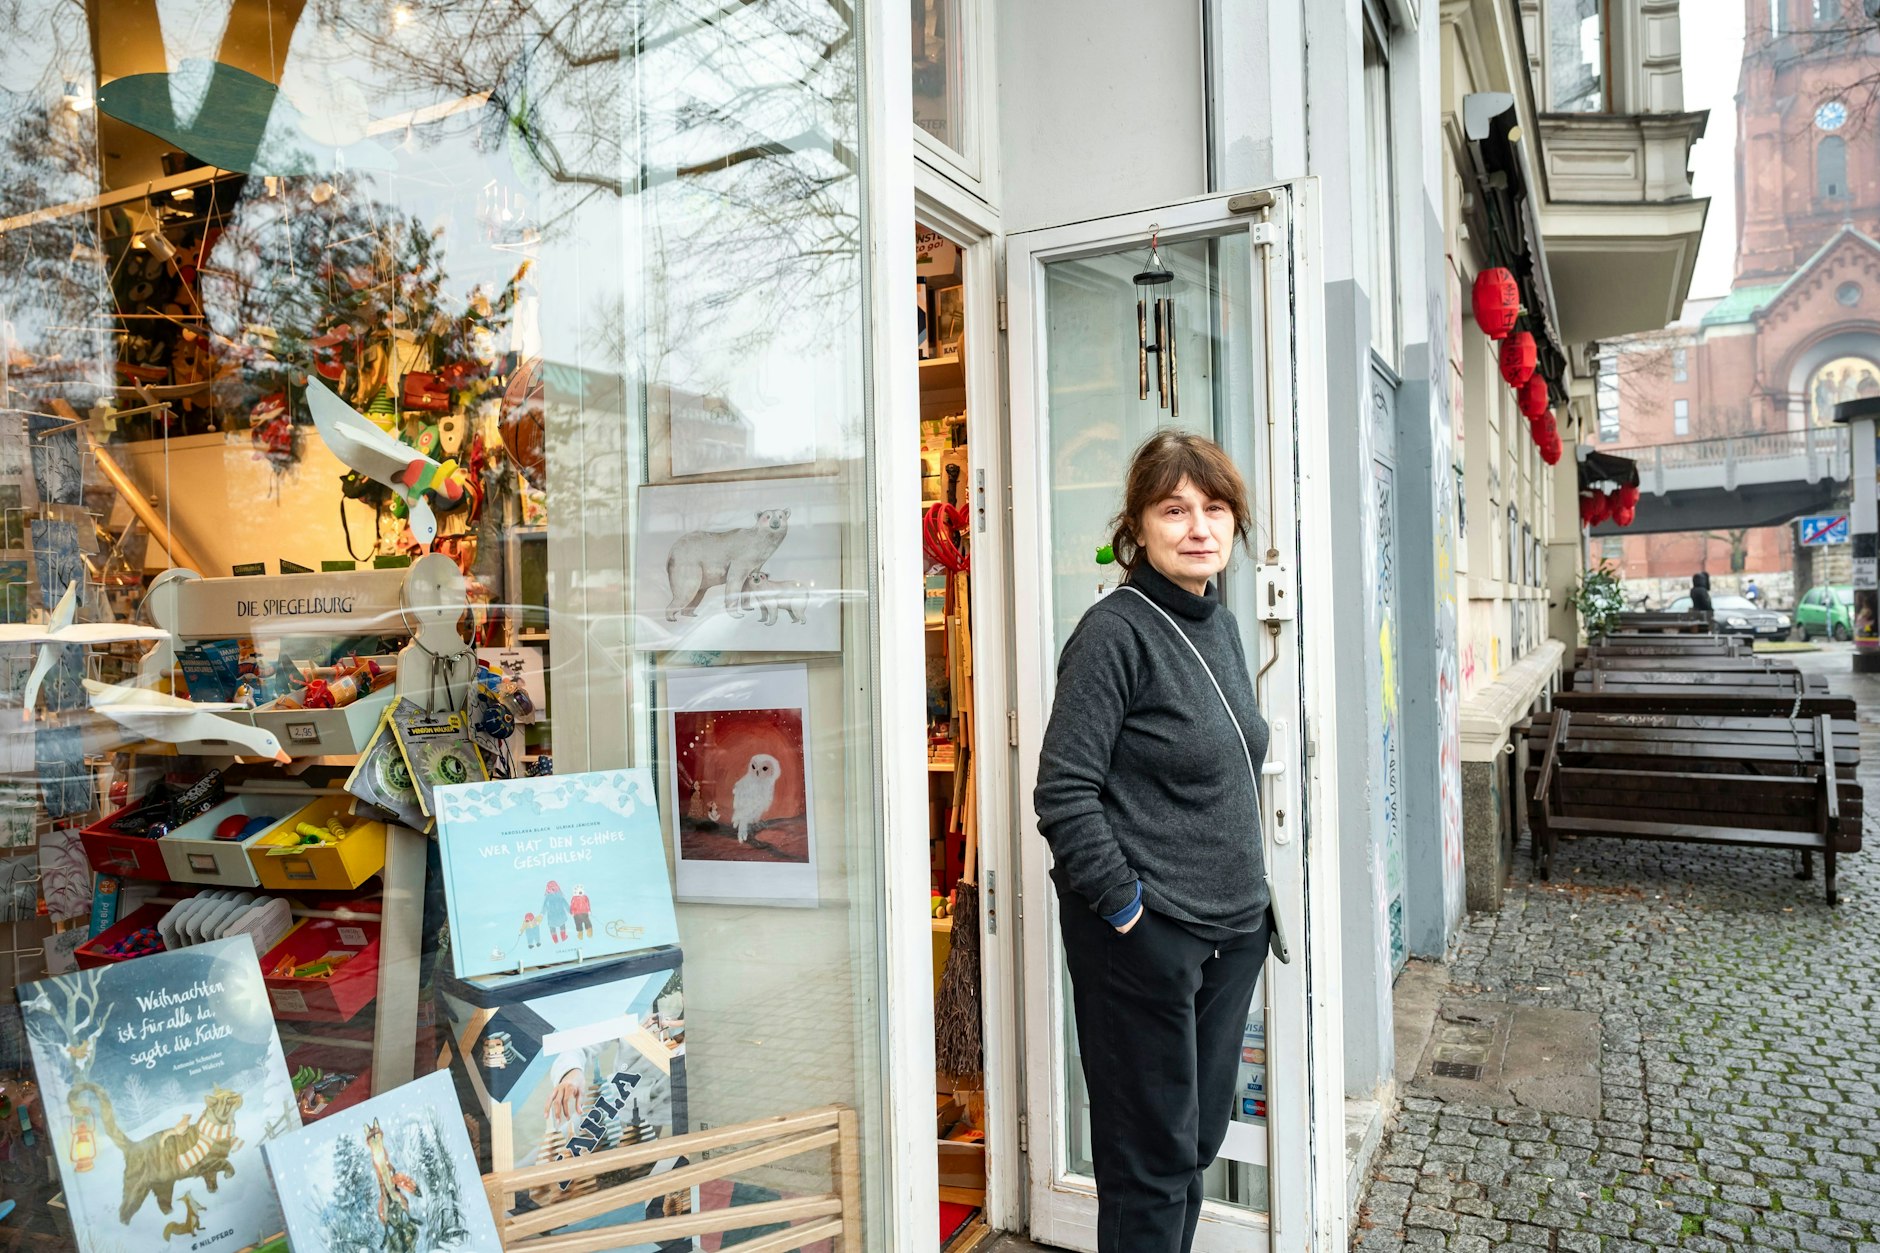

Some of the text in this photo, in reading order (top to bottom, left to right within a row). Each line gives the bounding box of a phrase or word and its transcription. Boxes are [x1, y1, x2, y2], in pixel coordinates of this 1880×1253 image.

[237, 597, 352, 617] DIE SPIEGELBURG
[177, 769, 220, 803] SHOOTING
[189, 784, 212, 801] STAR
[478, 844, 511, 858] WER
[516, 839, 543, 853] HAT
[550, 836, 573, 849] DEN
[100, 902, 110, 918] Bird
[136, 980, 225, 1013] Weihnachten
[118, 1022, 138, 1043] ist
[140, 1018, 166, 1041] für
[166, 1006, 193, 1029] alle
[130, 1023, 234, 1069] sagte die Katze
[200, 1228, 235, 1248] NILPFERD
